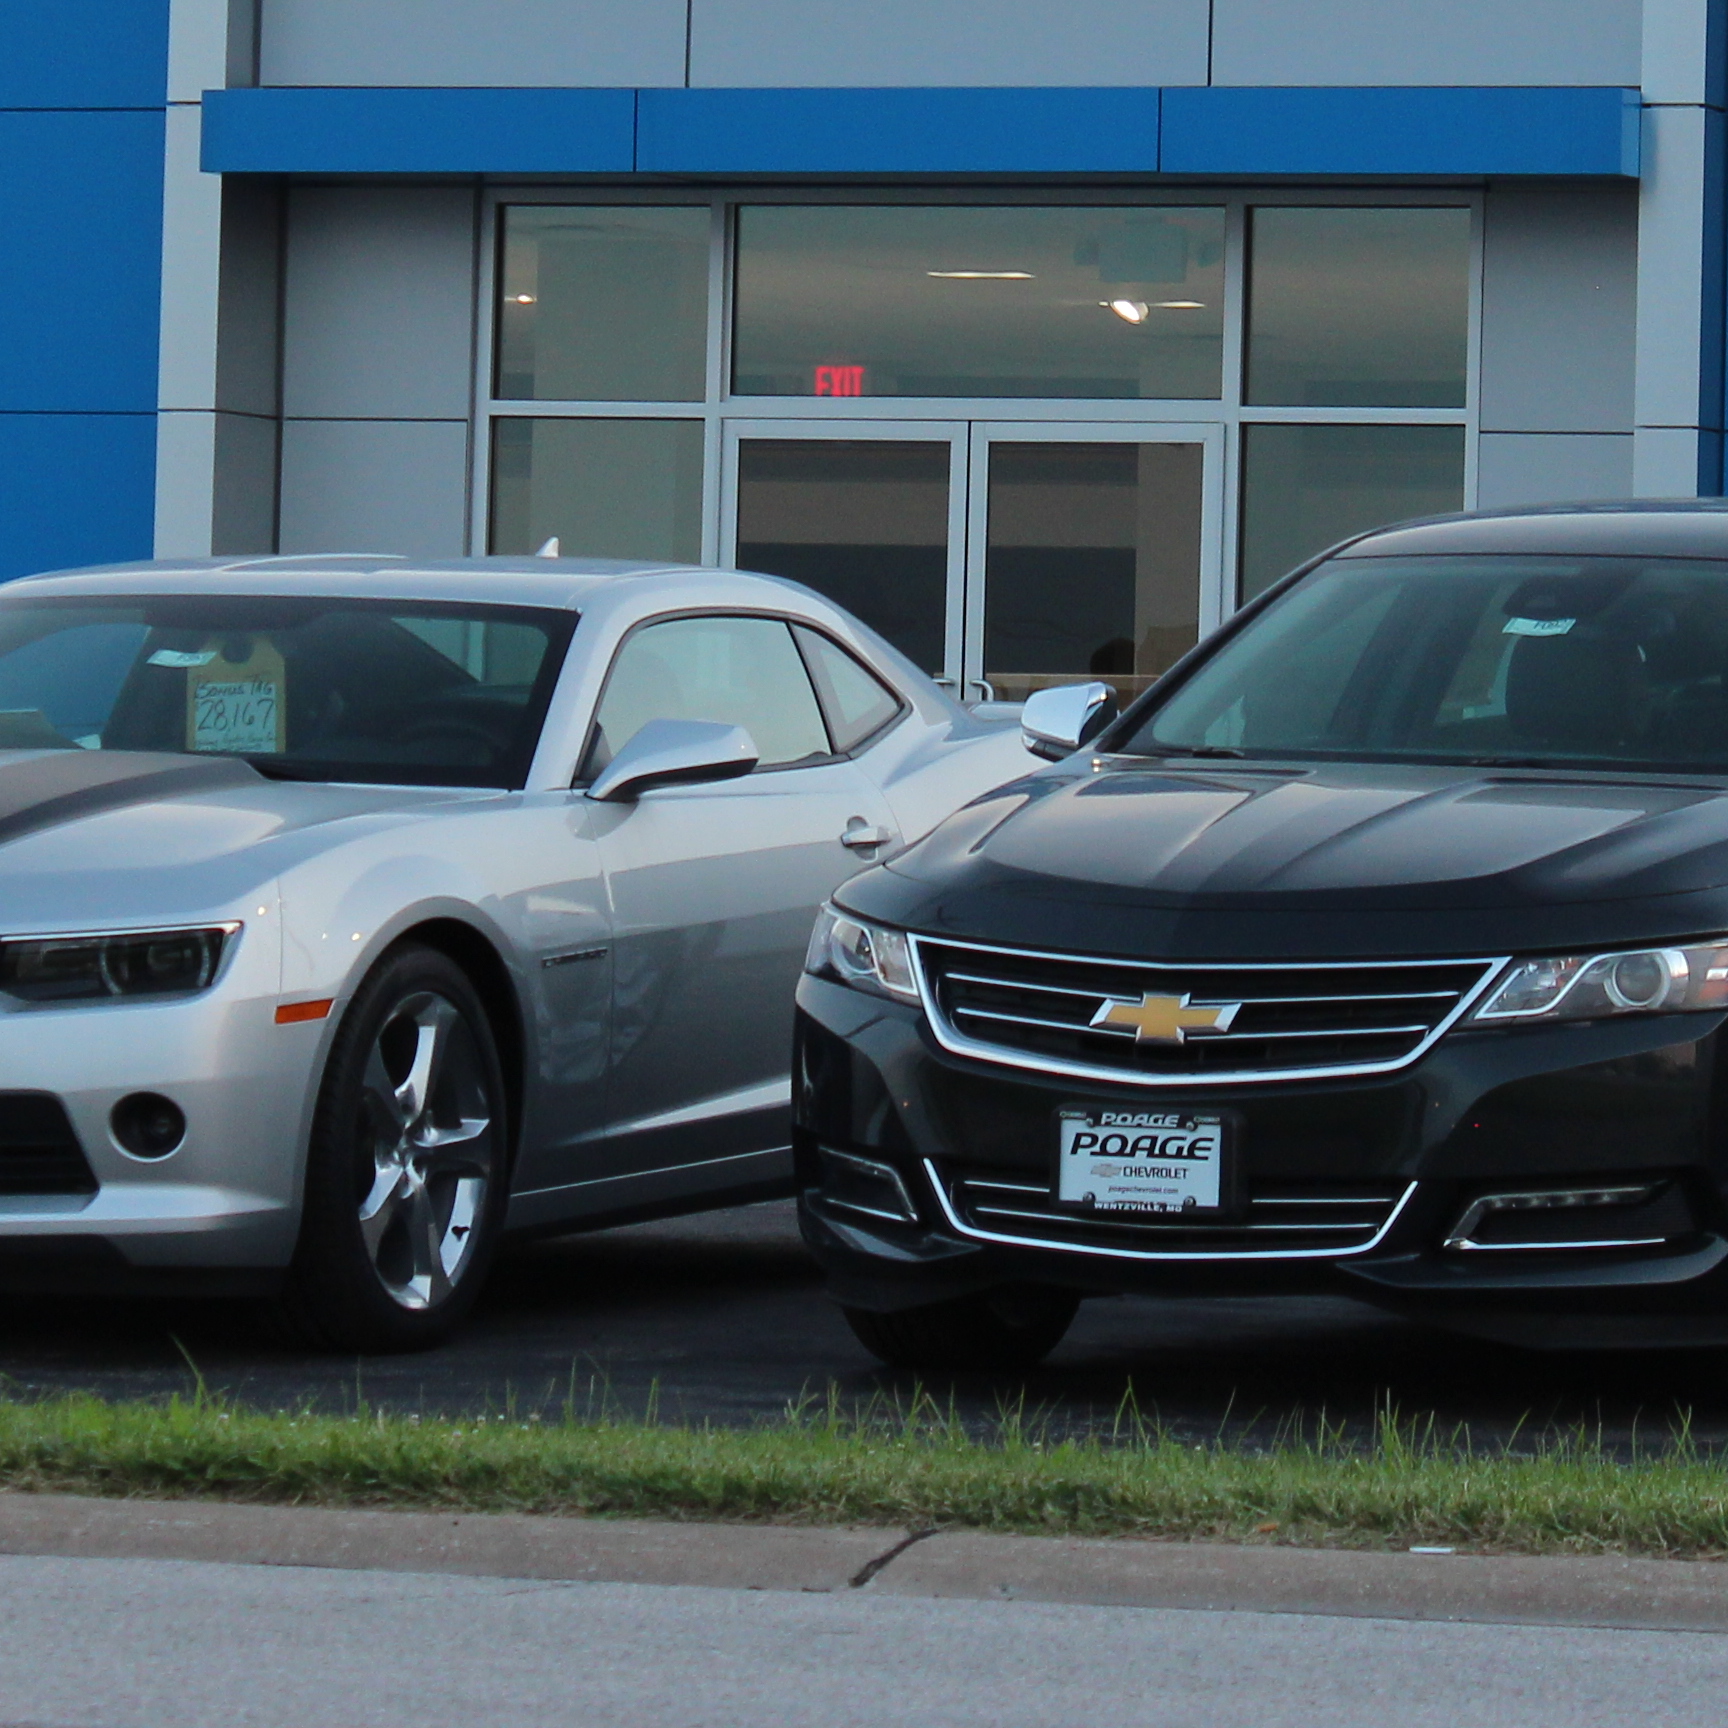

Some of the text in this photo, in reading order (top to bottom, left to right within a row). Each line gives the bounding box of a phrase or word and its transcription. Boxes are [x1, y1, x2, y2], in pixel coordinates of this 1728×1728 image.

[815, 365, 865, 397] EXIT
[1101, 1112, 1180, 1128] POAGE
[1070, 1132, 1215, 1160] POAGE
[1123, 1166, 1188, 1179] CHEVROLET
[1094, 1202, 1182, 1213] WENTZVILLE, MO
